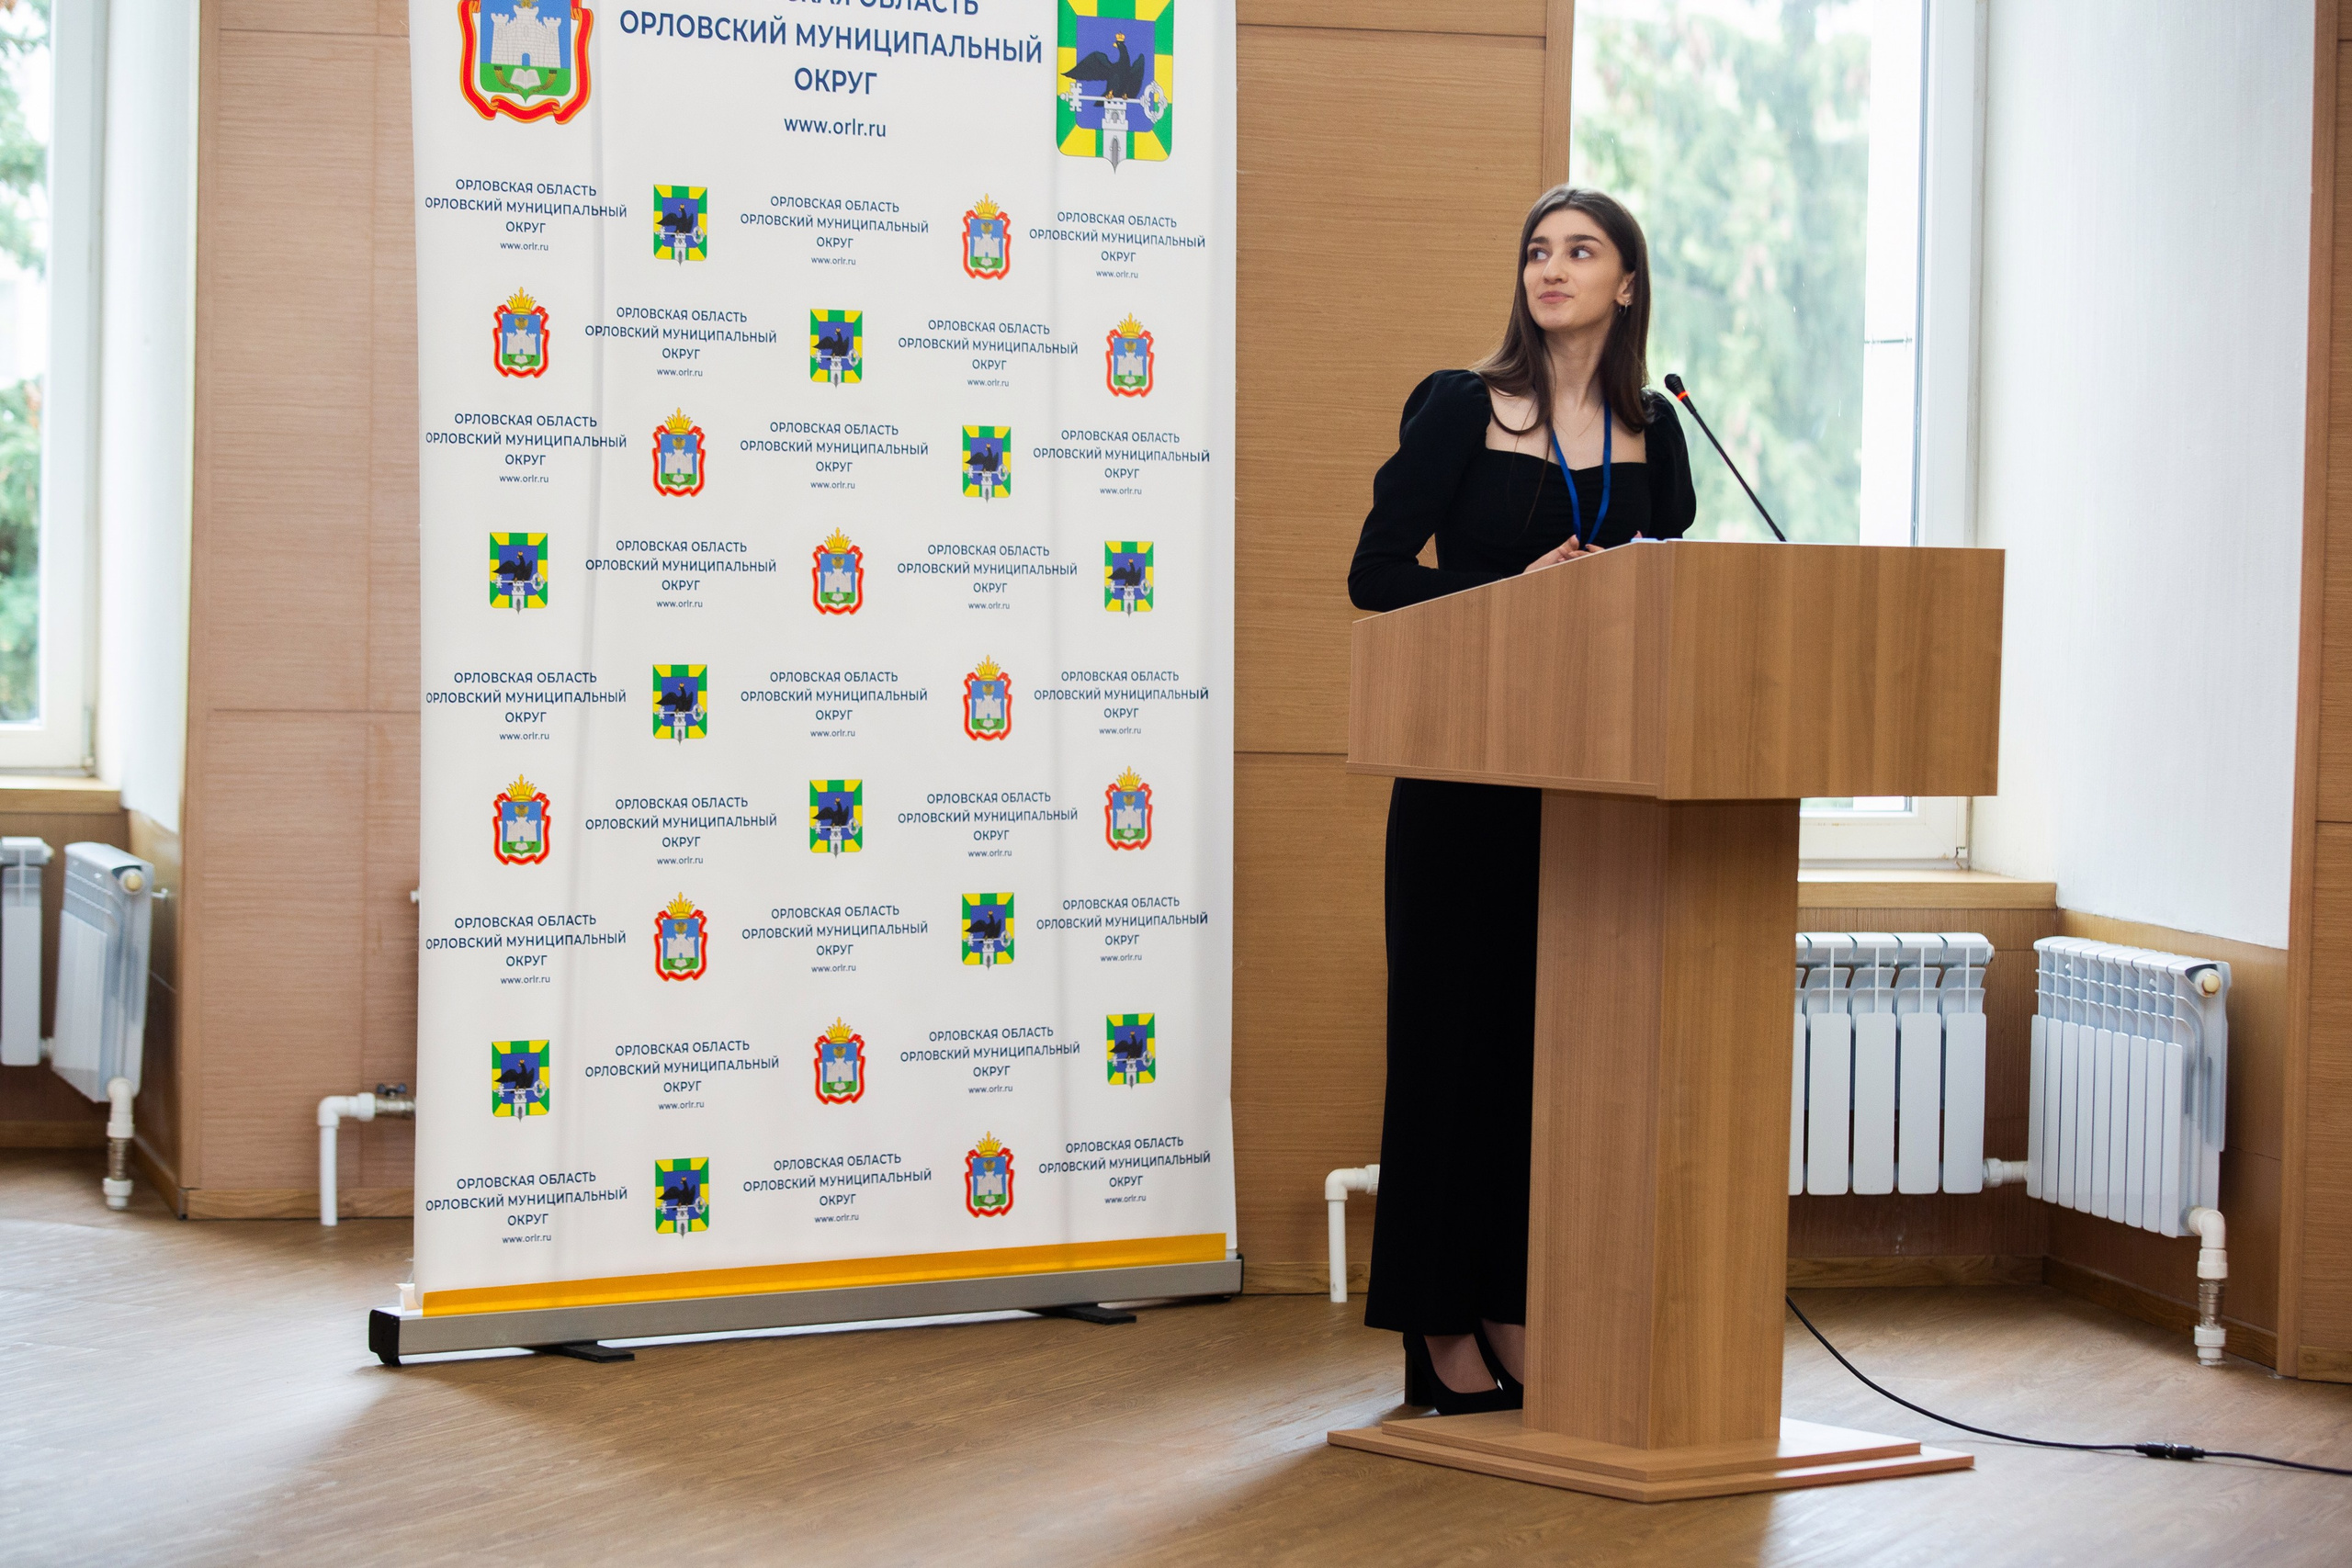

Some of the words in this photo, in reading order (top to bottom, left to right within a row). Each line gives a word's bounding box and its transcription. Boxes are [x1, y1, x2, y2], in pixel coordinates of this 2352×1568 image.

[619, 9, 786, 46] ОРЛОВСКИЙ
[796, 22, 1042, 64] МУНИЦИПАЛЬНЫЙ
[794, 66, 878, 96] ОКРУГ
[783, 118, 887, 138] www.orlr.ru
[455, 178, 534, 194] ОРЛОВСКАЯ
[536, 183, 597, 197] ОБЛАСТЬ
[424, 197, 503, 212] ОРЛОВСКИЙ
[506, 200, 628, 218] МУНИЦИПАЛЬНЫЙ
[770, 195, 842, 210] ОРЛОВСКАЯ
[844, 199, 900, 213] ОБЛАСТЬ
[505, 220, 547, 234] ОКРУГ
[740, 212, 814, 228] ОРЛОВСКИЙ
[817, 217, 929, 233] МУНИЦИПАЛЬНЫЙ
[1057, 211, 1125, 225] ОРЛОВСКАЯ
[1127, 215, 1178, 229] ОБЛАСТЬ
[816, 236, 854, 249] ОКРУГ
[1028, 228, 1099, 243] ОРЛОВСКИЙ
[1101, 231, 1205, 248] МУНИЦИПАЛЬНЫЙ
[499, 242, 549, 252] www.orlr.ru
[810, 256, 856, 265] www.orlr.ru
[1101, 250, 1136, 263] ОКРУГ
[1095, 270, 1139, 279] www.orlr.ru
[616, 306, 688, 321] ОРЛОВСКАЯ
[691, 310, 748, 323] ОБЛАСТЬ
[584, 324, 660, 339] ОРЛОВСКИЙ
[662, 328, 777, 344] МУНИЦИПАЛЬНЫЙ
[927, 319, 996, 333] ОРЛОВСКАЯ
[998, 321, 1051, 335] ОБЛАСТЬ
[898, 336, 969, 351] ОРЛОВСКИЙ
[972, 340, 1079, 355] МУНИЦИПАЛЬНЫЙ
[662, 347, 701, 360] ОКРУГ
[971, 358, 1008, 371] ОКРУГ
[656, 367, 704, 378] www.orlr.ru
[967, 378, 1010, 388] www.orlr.ru
[454, 412, 533, 426] ОРЛОВСКАЯ
[536, 414, 598, 428] ОБЛАСТЬ
[769, 421, 842, 434] ОРЛОВСКАЯ
[843, 423, 899, 436] ОБЛАСТЬ
[425, 431, 502, 446] ОРЛОВСКИЙ
[505, 434, 628, 449] МУНИЦИПАЛЬНЫЙ
[1060, 429, 1129, 442] ОРЛОВСКАЯ
[1131, 431, 1181, 444] ОБЛАСТЬ
[740, 438, 813, 453] ОРЛОВСКИЙ
[816, 441, 929, 457] МУНИЦИПАЛЬНЫЙ
[1033, 446, 1102, 460] ОРЛОВСКИЙ
[1104, 449, 1210, 463] МУНИЦИПАЛЬНЫЙ
[504, 454, 547, 466] ОКРУГ
[815, 460, 854, 473] ОКРУГ
[498, 474, 549, 483] www.orlr.ru
[1103, 468, 1140, 479] ОКРУГ
[809, 480, 856, 490] www.orlr.ru
[1099, 487, 1142, 495] www.orlr.ru
[616, 539, 688, 552] ОРЛОВСКАЯ
[691, 540, 748, 553] ОБЛАСТЬ
[927, 544, 997, 556] ОРЛОВСКАЯ
[999, 545, 1050, 557] ОБЛАСТЬ
[584, 557, 659, 571] ОРЛОВСКИЙ
[662, 558, 776, 574] МУНИЦИПАЛЬНЫЙ
[897, 560, 970, 574] ОРЛОВСКИЙ
[973, 562, 1078, 577] МУНИЦИПАЛЬНЫЙ
[661, 579, 701, 592] ОКРУГ
[972, 581, 1008, 593] ОКРУГ
[655, 599, 704, 608] www.orlr.ru
[967, 601, 1011, 610] www.orlr.ru
[453, 671, 533, 684] ОРЛОВСКАЯ
[536, 671, 597, 683] ОБЛАСТЬ
[769, 671, 841, 683] ОРЛОВСКАЯ
[843, 671, 899, 682] ОБЛАСТЬ
[1060, 671, 1128, 682] ОРЛОВСКАЯ
[1130, 671, 1180, 682] ОБЛАСТЬ
[425, 689, 502, 704] ОРЛОВСКИЙ
[505, 688, 627, 705] МУНИЦИПАЛЬНЫЙ
[740, 687, 813, 703] ОРЛОВСКИЙ
[816, 687, 928, 704] МУНИЦИПАЛЬНЫЙ
[1034, 687, 1102, 701] ОРЛОВСКИЙ
[1103, 686, 1209, 702] МУНИЦИПАЛЬНЫЙ
[504, 711, 548, 724] ОКРУГ
[815, 709, 854, 721] ОКРУГ
[1103, 707, 1139, 719] ОКРУГ
[499, 731, 550, 740] www.orlr.ru
[809, 728, 856, 738] www.orlr.ru
[1098, 726, 1142, 735] www.orlr.ru
[615, 797, 688, 810] ОРЛОВСКАЯ
[691, 796, 749, 809] ОБЛАСТЬ
[926, 792, 999, 805] ОРЛОВСКАЯ
[1001, 791, 1052, 804] ОБЛАСТЬ
[584, 815, 659, 830] ОРЛОВСКИЙ
[662, 812, 777, 829] МУНИЦИПАЛЬНЫЙ
[897, 808, 970, 824] ОРЛОВСКИЙ
[973, 807, 1079, 824] МУНИЦИПАЛЬНЫЙ
[662, 836, 701, 848] ОКРУГ
[973, 829, 1011, 841] ОКРУГ
[656, 855, 704, 865] www.orlr.ru
[967, 848, 1012, 858] www.orlr.ru
[1062, 897, 1129, 911] ОРЛОВСКАЯ
[1131, 896, 1181, 908] ОБЛАСТЬ
[771, 906, 842, 919] ОРЛОВСКАЯ
[844, 905, 900, 918] ОБЛАСТЬ
[454, 915, 534, 930] ОРЛОВСКАЯ
[537, 914, 597, 927] ОБЛАСТЬ
[1035, 914, 1102, 931] ОРЛОВСКИЙ
[1104, 910, 1208, 929] МУНИЦИПАЛЬНЫЙ
[741, 923, 813, 940] ОРЛОВСКИЙ
[816, 919, 928, 938] МУНИЦИПАЛЬНЫЙ
[425, 933, 503, 950] ОРЛОВСКИЙ
[506, 930, 627, 949] МУНИЦИПАЛЬНЫЙ
[1104, 933, 1140, 946] ОКРУГ
[816, 943, 854, 956] ОКРУГ
[505, 954, 548, 967] ОКРУГ
[1100, 953, 1143, 962] www.orlr.ru
[810, 964, 857, 973] www.orlr.ru
[500, 975, 551, 985] www.orlr.ru
[928, 1028, 999, 1043] ОРЛОВСКАЯ
[1001, 1026, 1054, 1039] ОБЛАСТЬ
[615, 1042, 689, 1057] ОРЛОВСКАЯ
[692, 1040, 751, 1054] ОБЛАСТЬ
[899, 1045, 970, 1063] ОРЛОВСКИЙ
[973, 1041, 1080, 1059] МУНИЦИПАЛЬНЫЙ
[584, 1060, 661, 1078] ОРЛОВСКИЙ
[663, 1055, 780, 1074] МУНИЦИПАЛЬНЫЙ
[972, 1065, 1012, 1077] ОКРУГ
[662, 1079, 703, 1093] ОКРУГ
[967, 1084, 1013, 1094] www.orlr.ru
[658, 1100, 705, 1111] www.orlr.ru
[1065, 1139, 1132, 1154] ОРЛОВСКАЯ
[1134, 1135, 1184, 1150] ОБЛАСТЬ
[773, 1156, 844, 1171] ОРЛОВСКАЯ
[846, 1153, 902, 1167] ОБЛАСТЬ
[1038, 1156, 1106, 1174] ОРЛОВСКИЙ
[1109, 1149, 1211, 1169] МУНИЦИПАЛЬНЫЙ
[456, 1174, 535, 1190] ОРЛОВСКАЯ
[538, 1170, 597, 1186] ОБЛАСТЬ
[742, 1174, 816, 1192] ОРЛОВСКИЙ
[819, 1168, 933, 1188] МУНИЦИПАЛЬНЫЙ
[1108, 1175, 1144, 1188] ОКРУГ
[425, 1192, 504, 1212] ОРЛОВСКИЙ
[507, 1186, 628, 1207] МУНИЦИПАЛЬНЫЙ
[819, 1193, 857, 1207] ОКРУГ
[1103, 1194, 1147, 1204] www.orlr.ru
[506, 1213, 549, 1226] ОКРУГ
[814, 1213, 860, 1224] www.orlr.ru
[501, 1233, 552, 1244] www.orlr.ru
